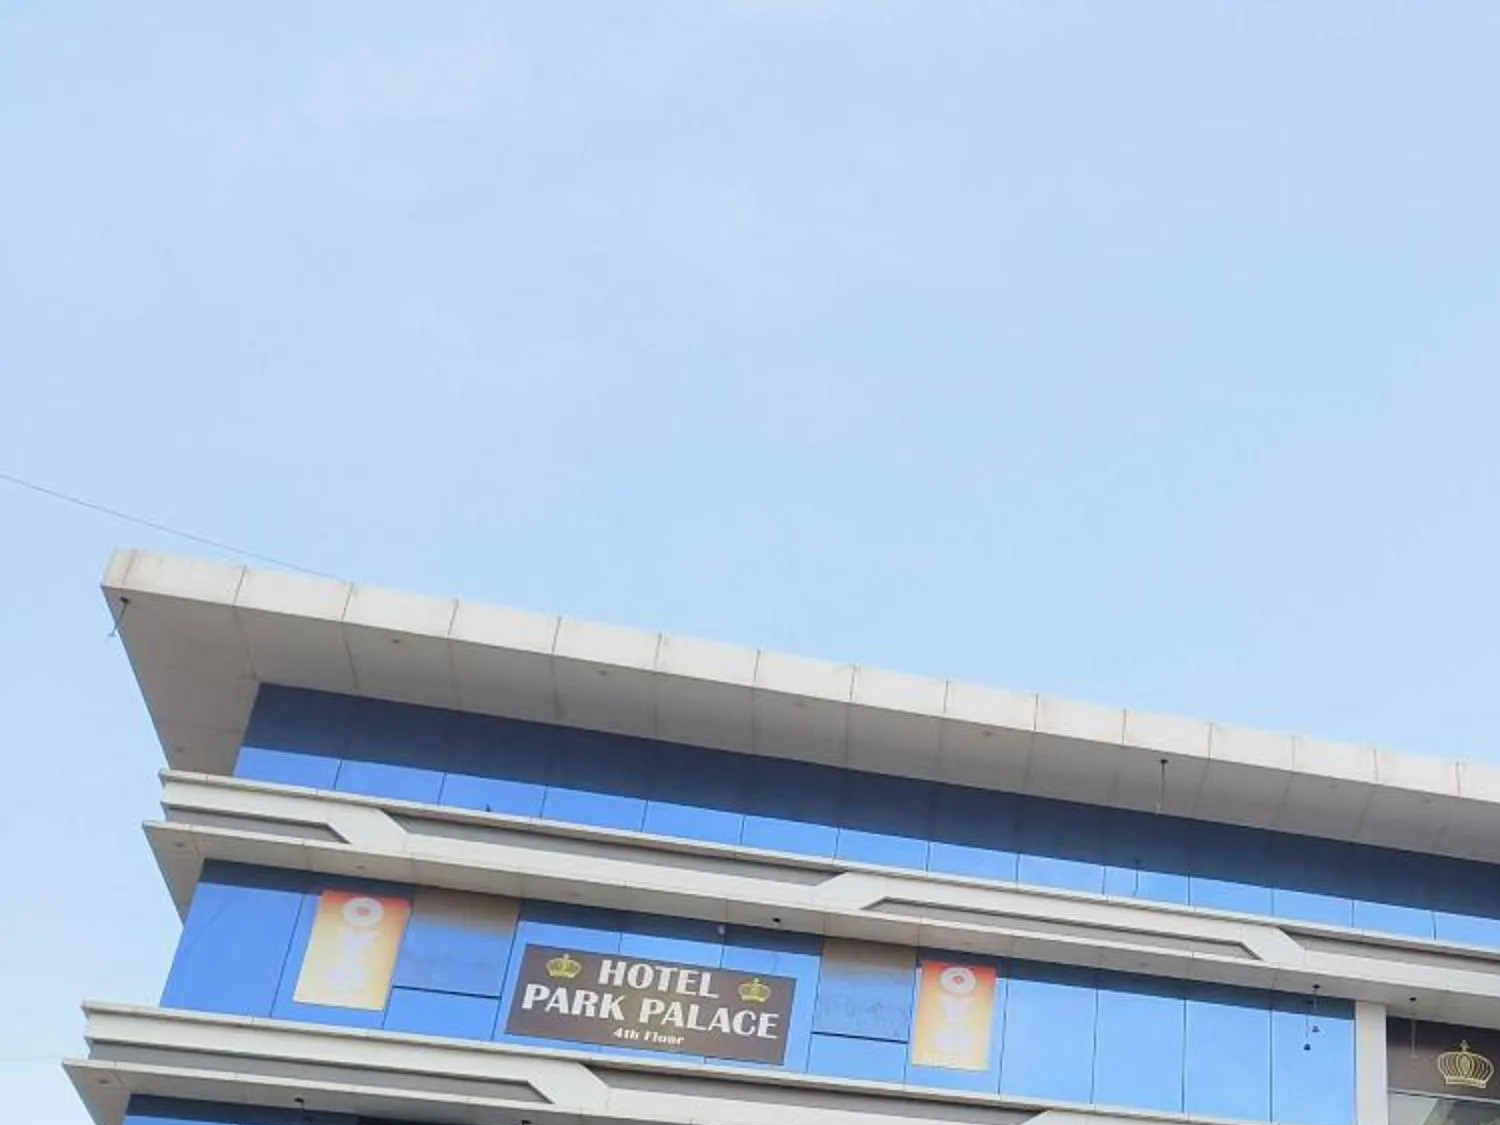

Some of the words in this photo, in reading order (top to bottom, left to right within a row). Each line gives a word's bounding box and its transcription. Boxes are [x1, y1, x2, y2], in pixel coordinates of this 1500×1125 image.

[598, 959, 719, 999] HOTEL
[522, 983, 625, 1021] PARK
[638, 998, 779, 1039] PALACE
[613, 1027, 639, 1041] 4th
[643, 1031, 685, 1046] Floor
